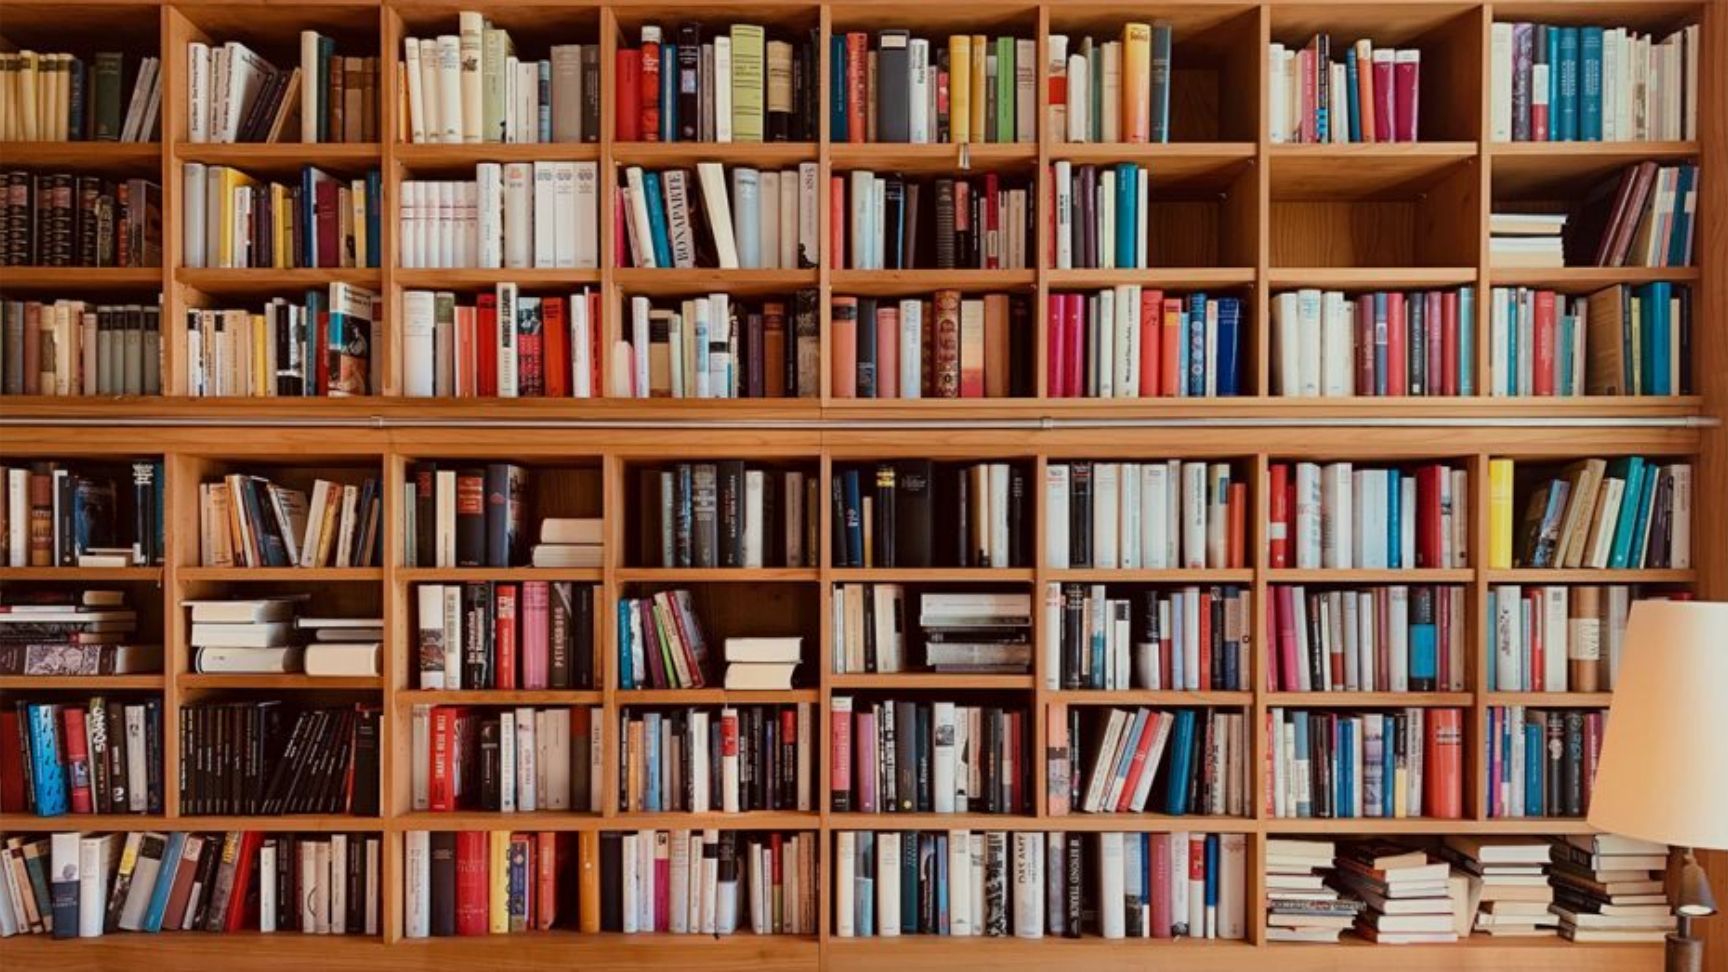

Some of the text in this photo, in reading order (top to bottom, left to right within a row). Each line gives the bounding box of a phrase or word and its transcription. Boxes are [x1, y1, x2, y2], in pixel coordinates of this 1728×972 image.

[669, 172, 689, 262] BONAPARTE
[554, 606, 564, 668] PETERSBURG
[436, 752, 446, 779] SMARTE
[1070, 848, 1080, 918] BEYOND TERROR
